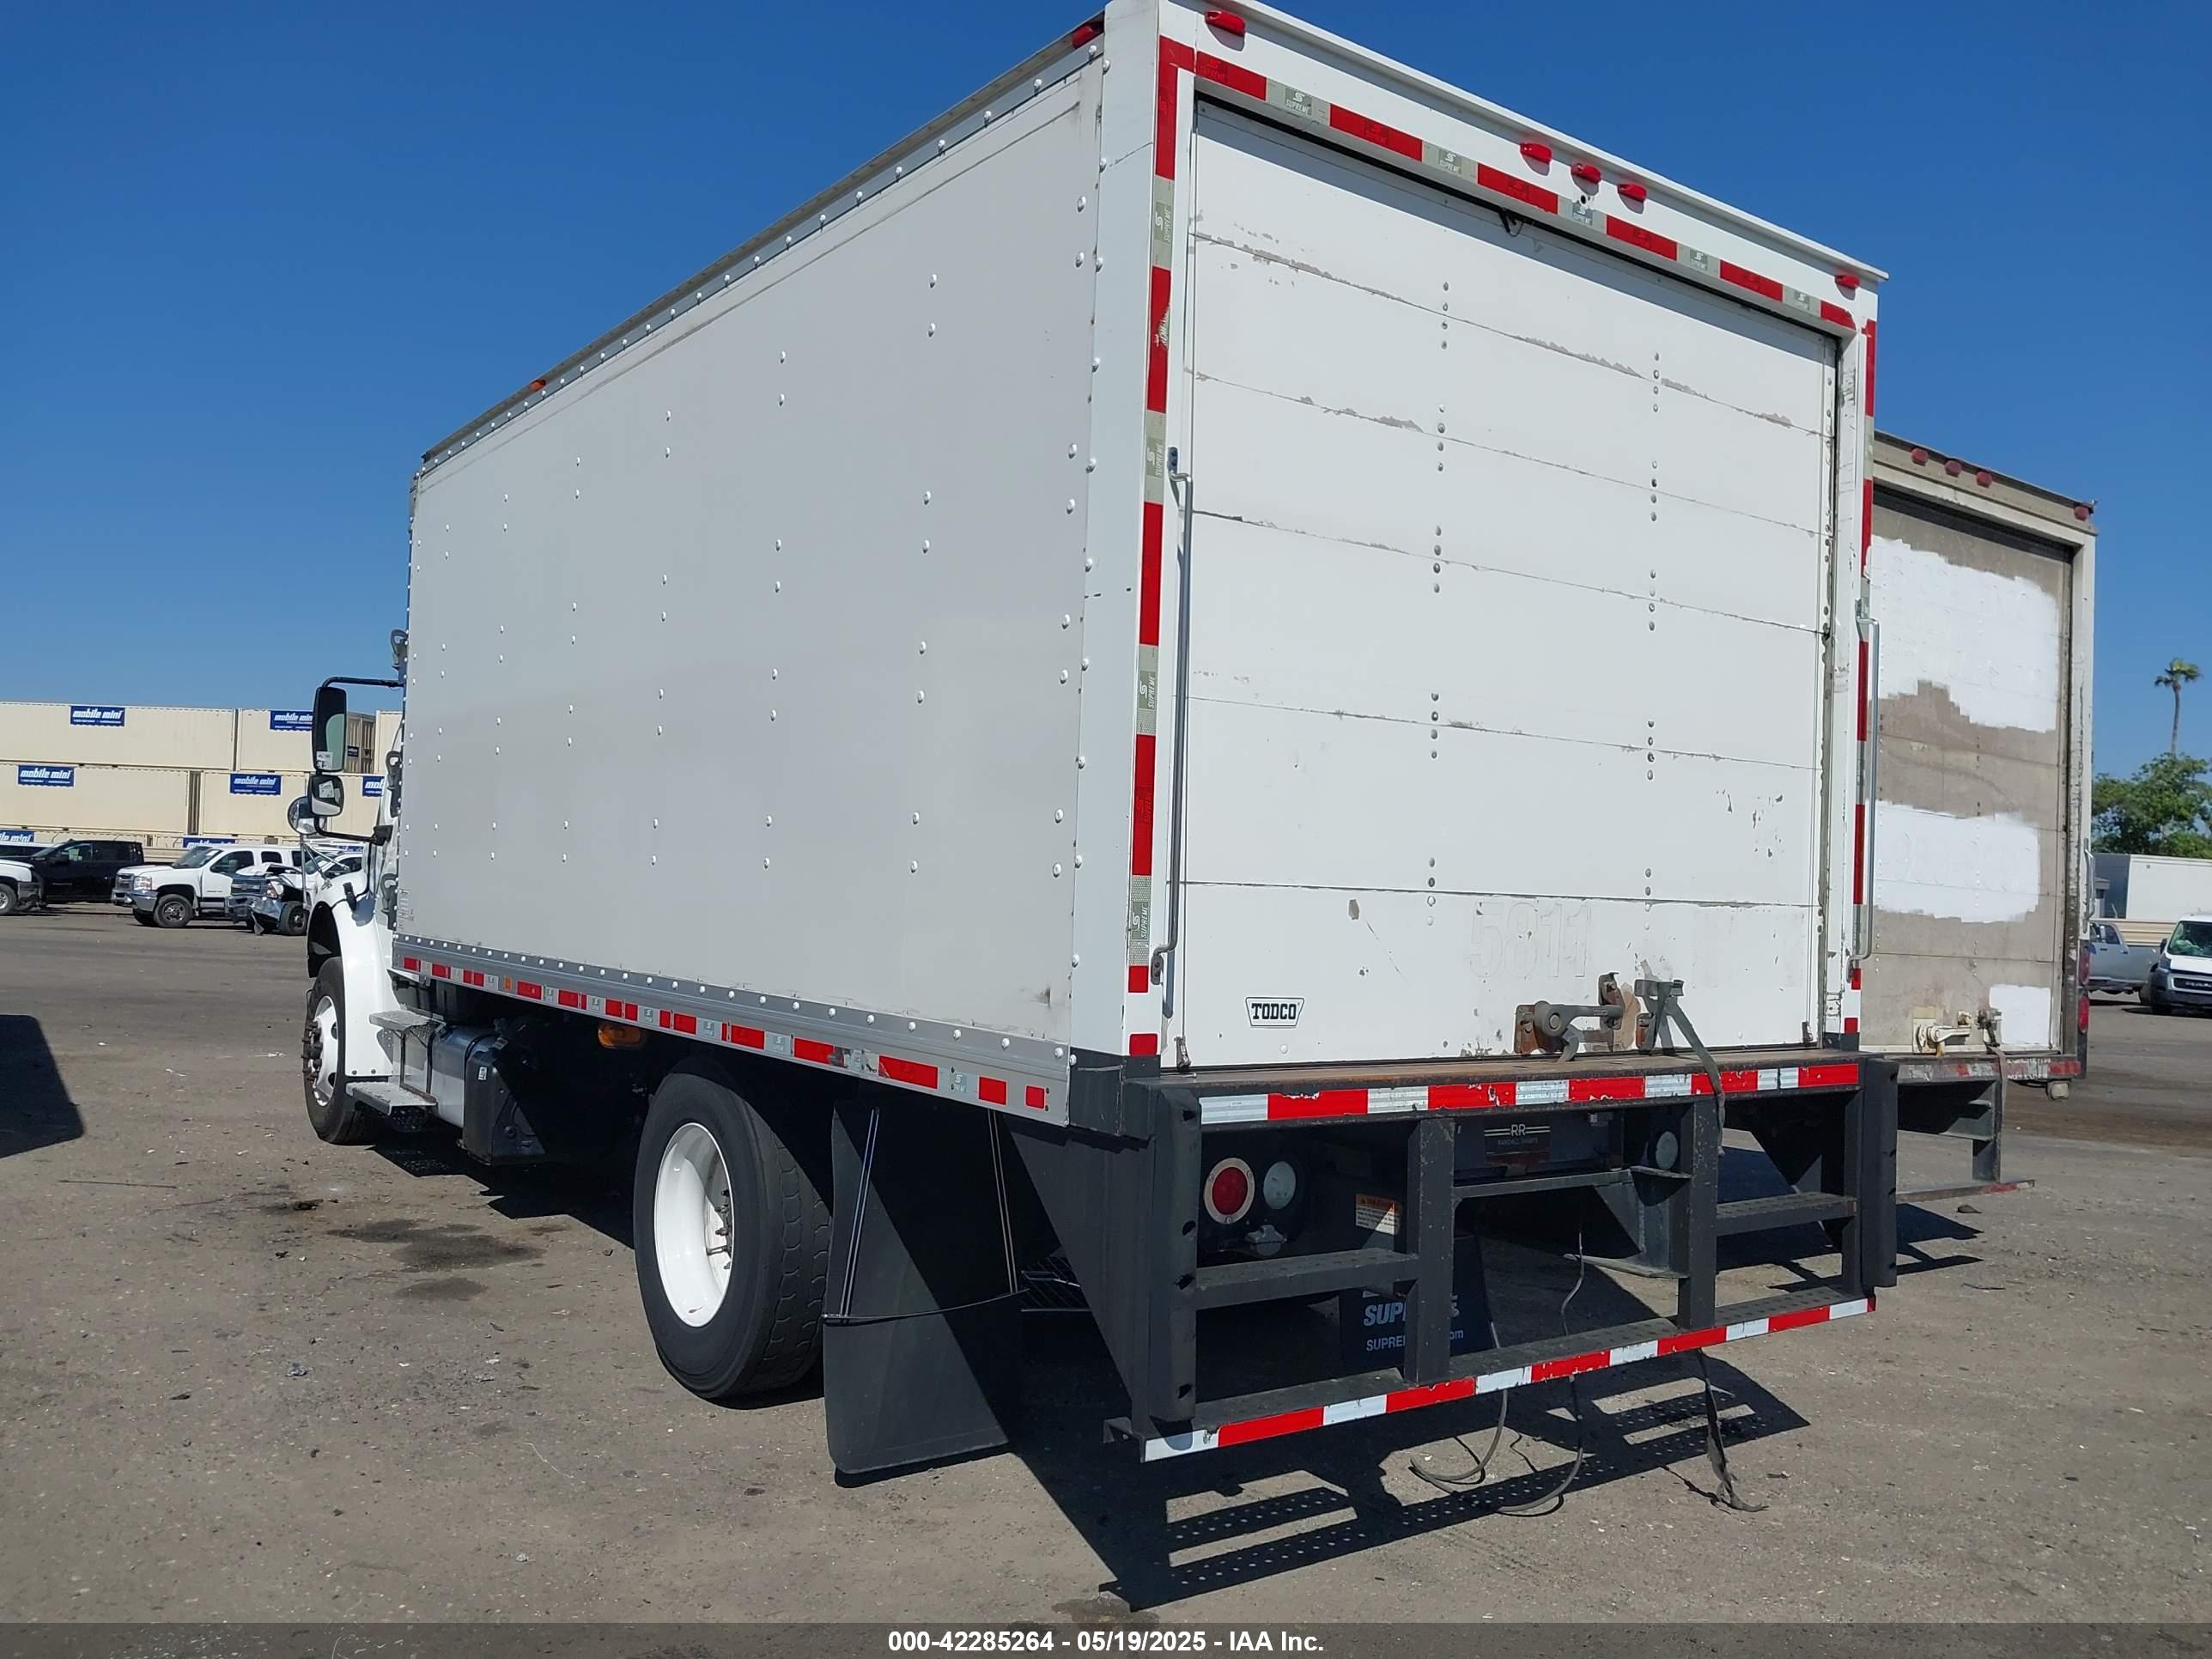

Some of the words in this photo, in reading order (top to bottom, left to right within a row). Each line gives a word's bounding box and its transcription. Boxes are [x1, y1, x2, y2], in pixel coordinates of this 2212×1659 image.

[72, 708, 101, 719] mobile
[101, 710, 123, 720] mini
[274, 712, 298, 721] mobile
[20, 768, 50, 779] mobile
[50, 769, 71, 780] mini
[234, 775, 259, 785] mobile
[259, 777, 276, 786] mini
[1251, 1002, 1297, 1020] TODCO
[1510, 1123, 1527, 1137] RR
